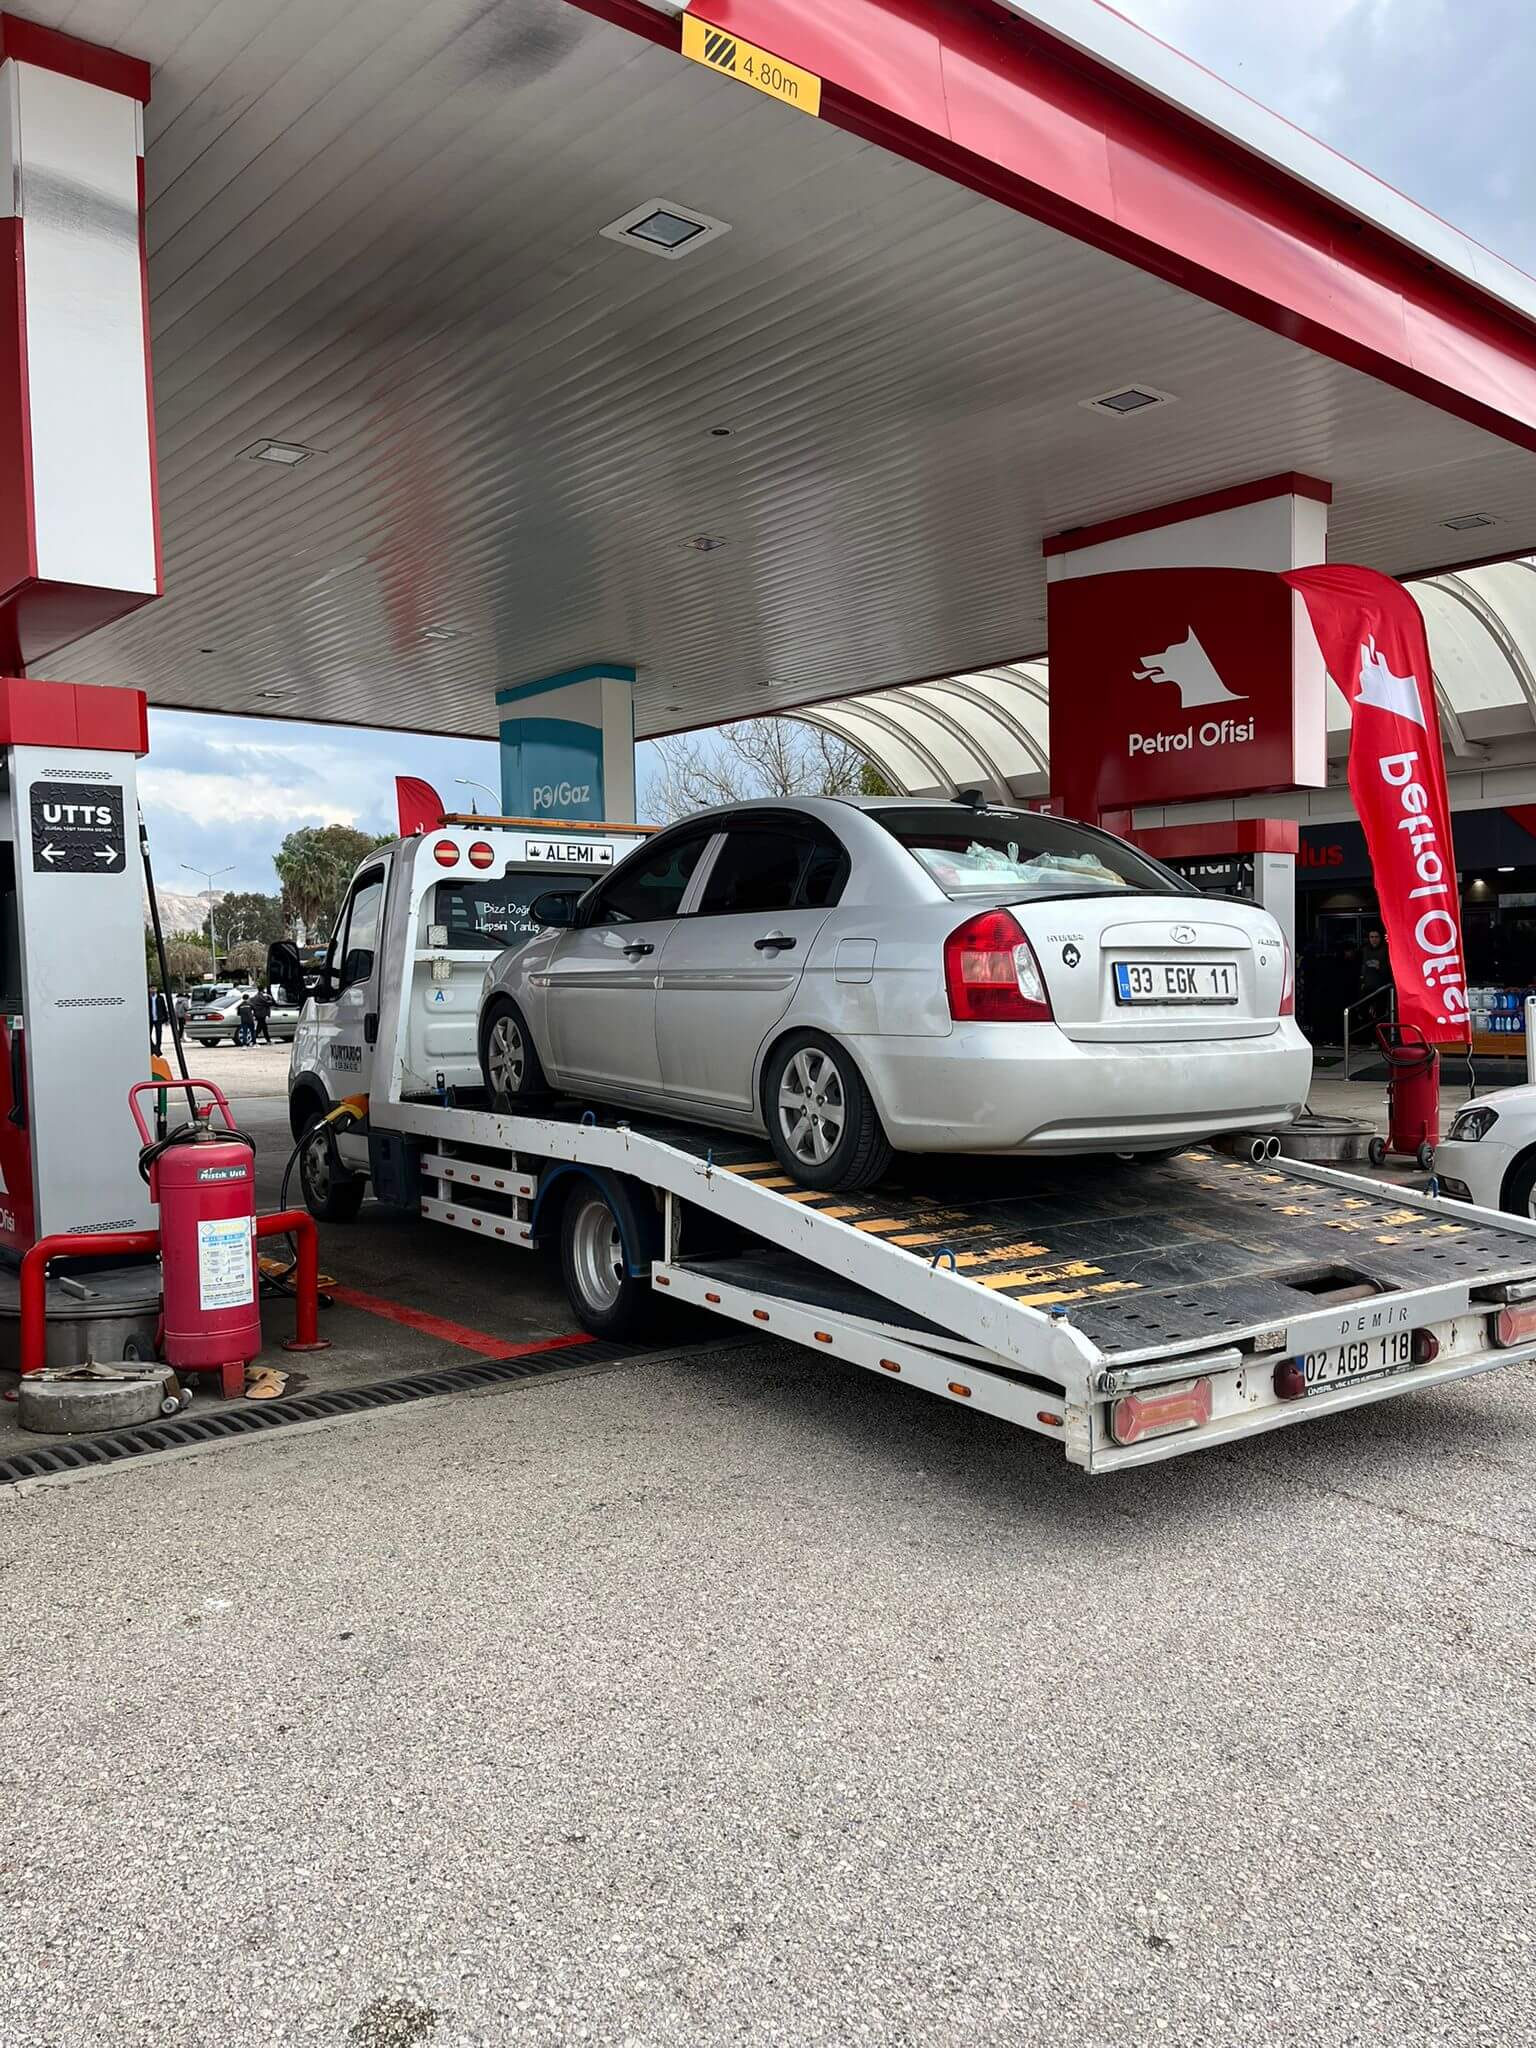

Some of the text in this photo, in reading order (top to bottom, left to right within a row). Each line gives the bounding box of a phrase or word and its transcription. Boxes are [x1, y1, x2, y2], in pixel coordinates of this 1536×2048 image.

[743, 56, 799, 99] 4.80m
[1129, 717, 1255, 757] Petrol Ofisi
[43, 804, 112, 825] UTTS
[546, 845, 594, 862] ALEMI
[1296, 838, 1344, 868] lus
[483, 903, 506, 914] Bize
[475, 919, 508, 932] Hepsini
[1130, 967, 1153, 993] 33
[1165, 967, 1199, 994] EGK
[1211, 968, 1230, 994] 11
[1341, 1307, 1408, 1335] DEMİR
[1306, 1351, 1328, 1382] 02
[1337, 1342, 1369, 1376] AGB
[1380, 1332, 1409, 1365] 118
